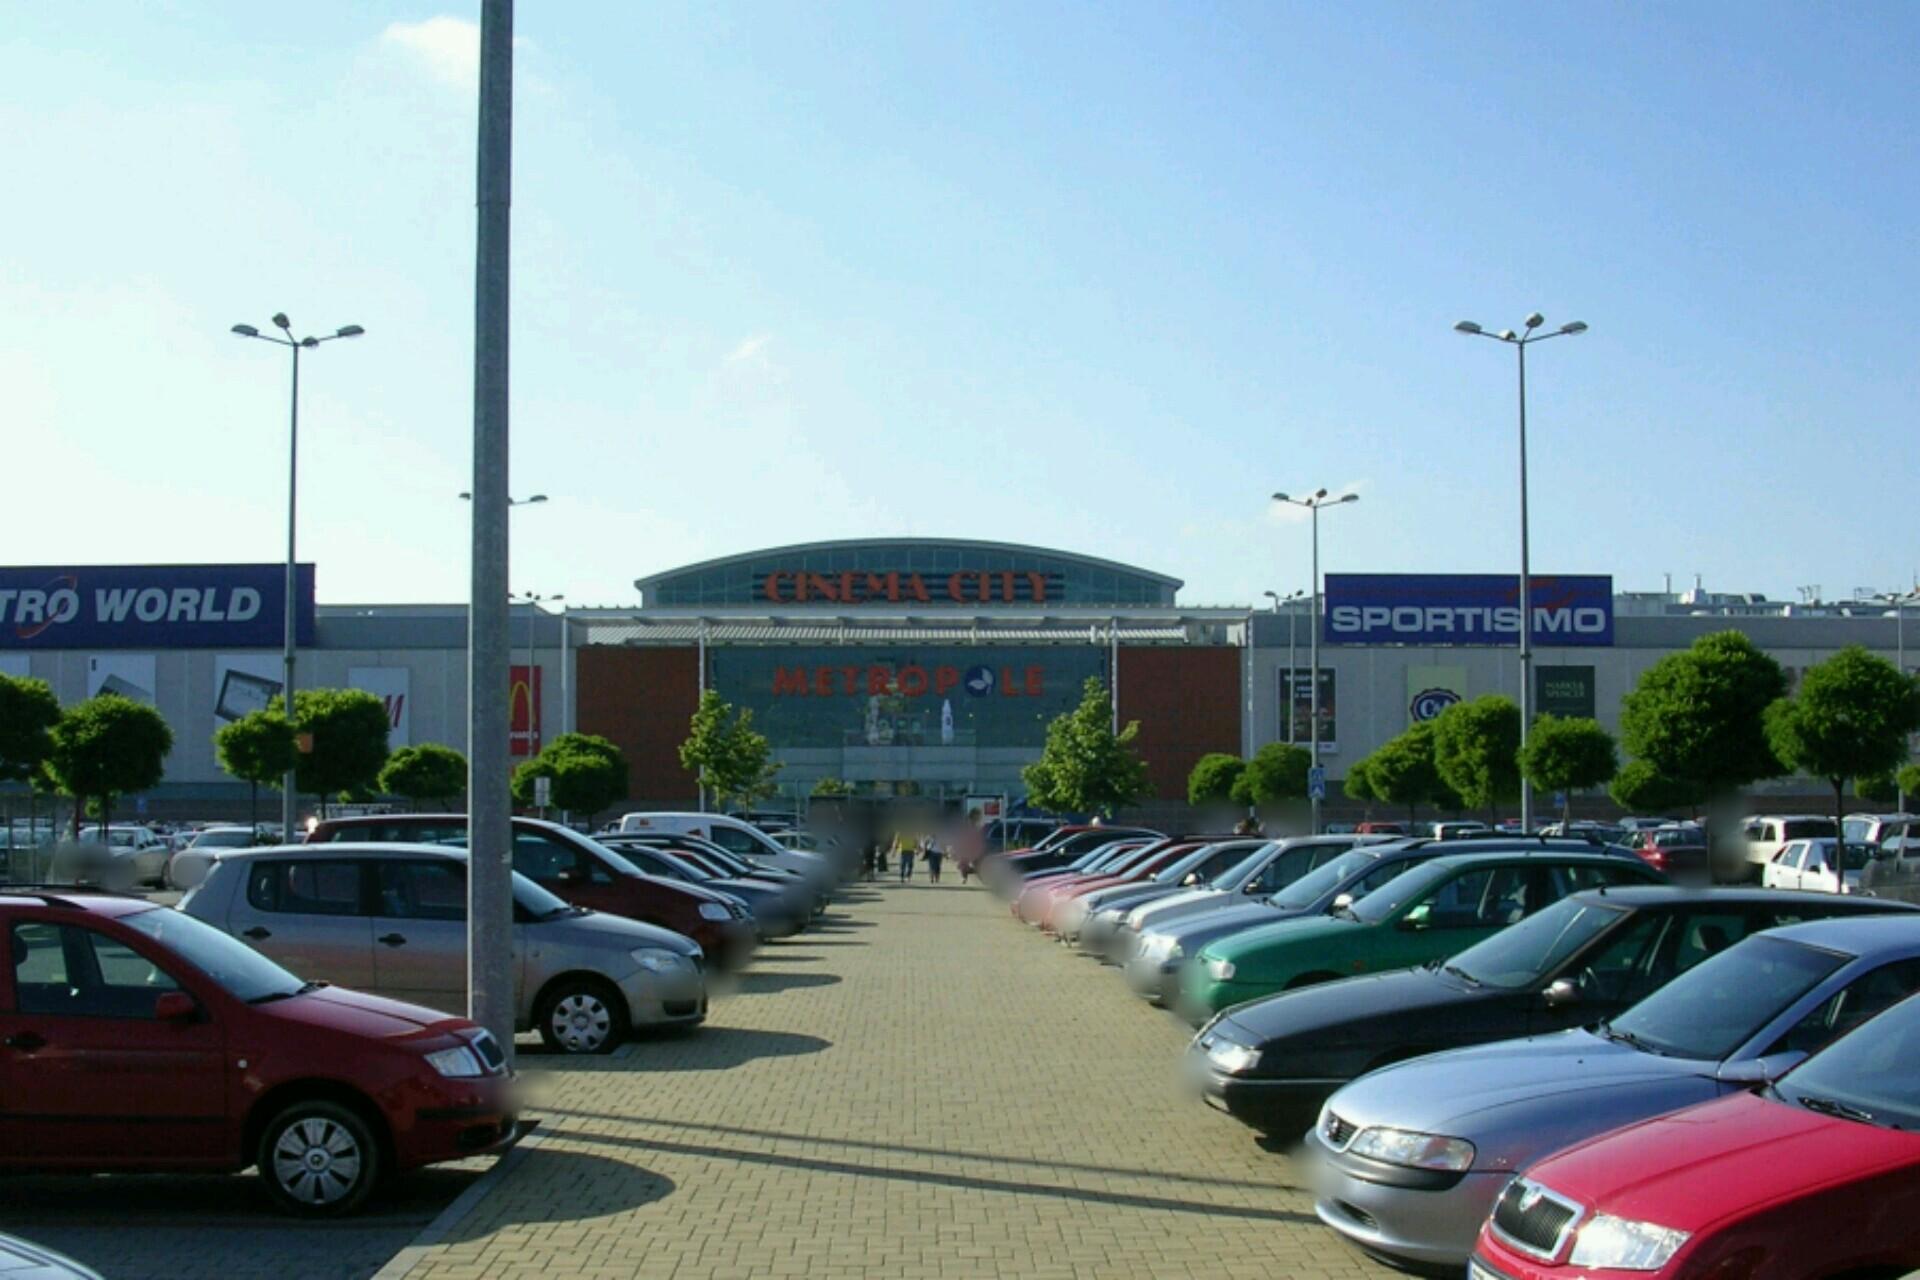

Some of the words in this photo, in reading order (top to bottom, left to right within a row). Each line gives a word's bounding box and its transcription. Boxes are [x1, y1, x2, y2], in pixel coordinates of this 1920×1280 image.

[764, 571, 931, 604] CINEMA
[947, 571, 1050, 604] CITY
[95, 587, 262, 623] WORLD
[1332, 606, 1607, 633] SPORTISMO
